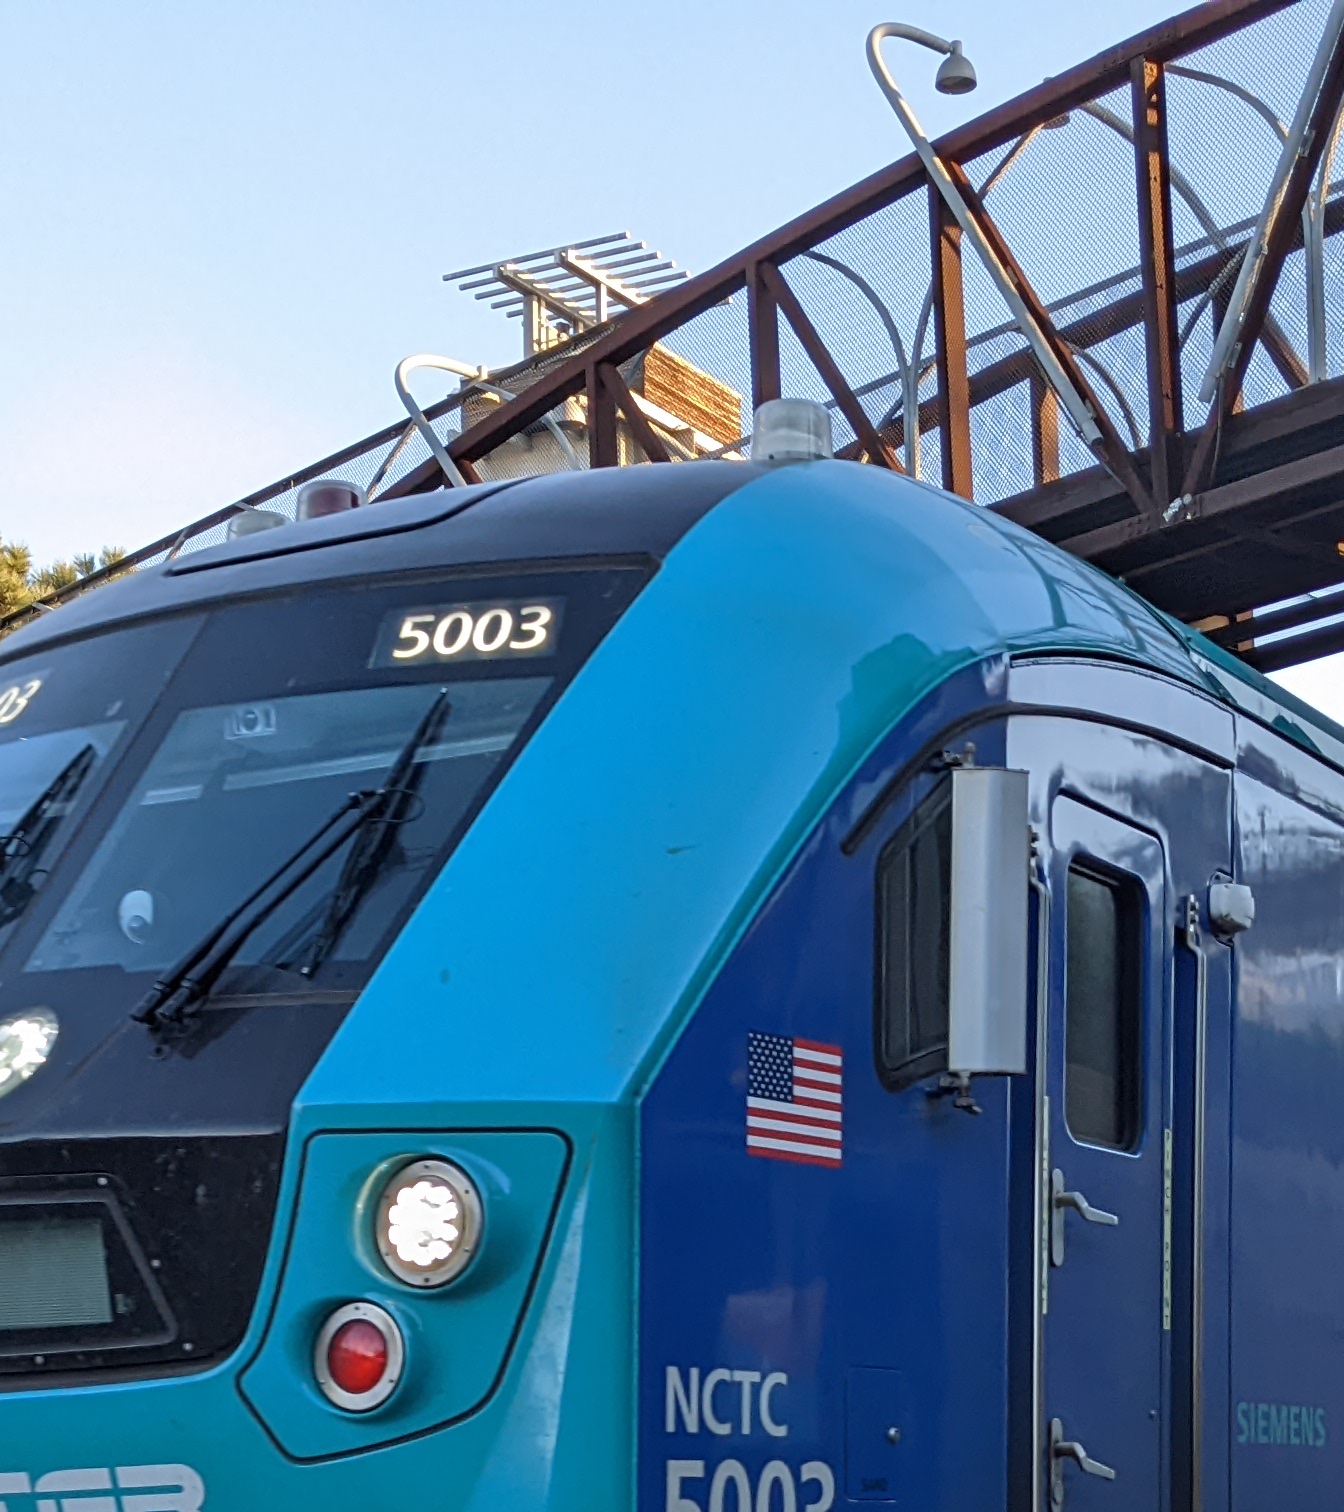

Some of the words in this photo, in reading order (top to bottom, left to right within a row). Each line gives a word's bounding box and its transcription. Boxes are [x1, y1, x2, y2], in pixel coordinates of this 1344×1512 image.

[392, 605, 552, 659] 5003
[665, 1365, 789, 1437] NCTC
[1237, 1401, 1326, 1447] SIEMENS
